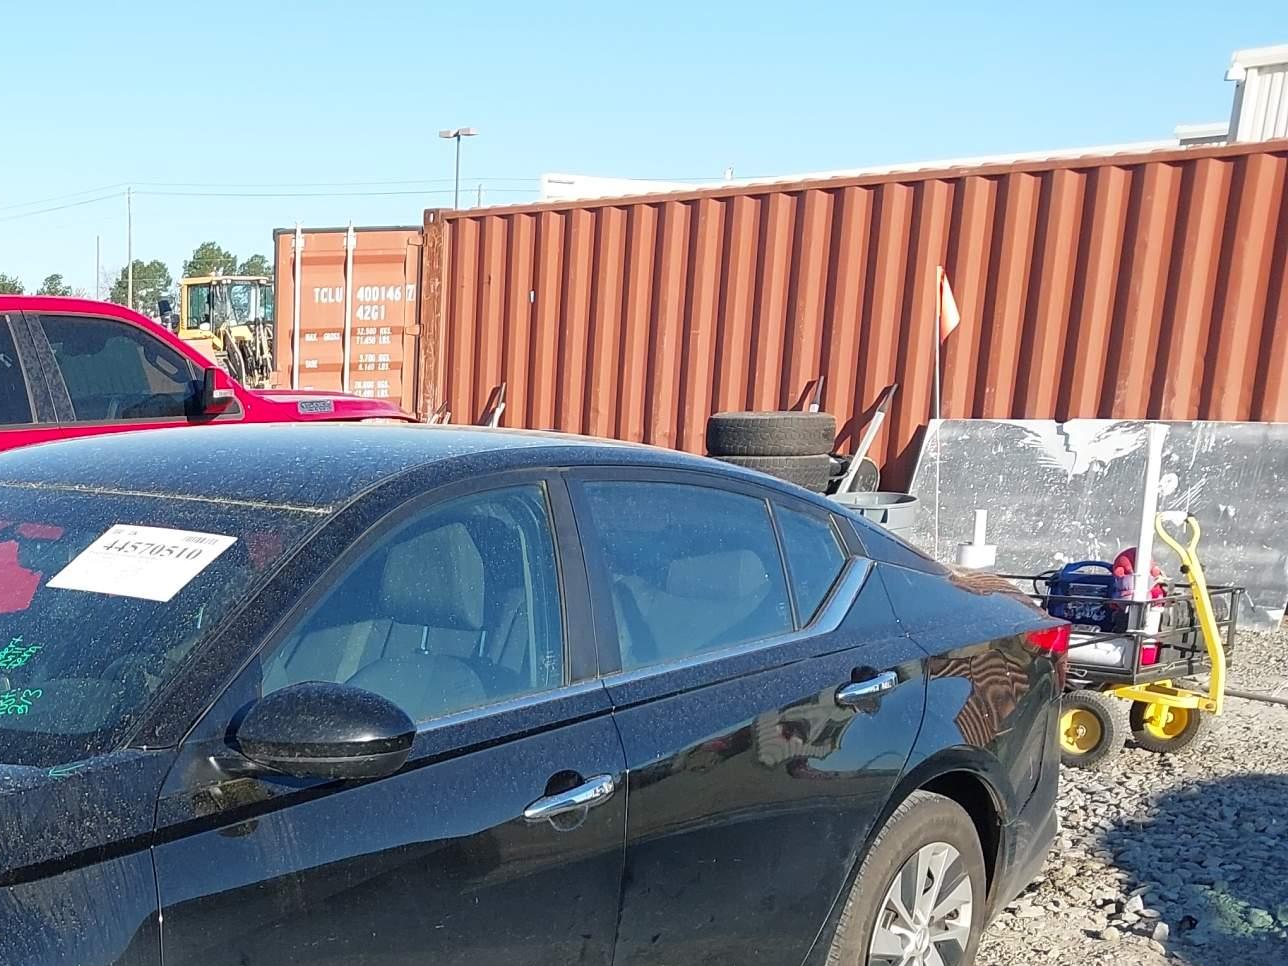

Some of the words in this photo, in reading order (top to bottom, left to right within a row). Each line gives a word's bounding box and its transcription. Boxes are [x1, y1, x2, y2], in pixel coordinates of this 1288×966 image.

[313, 287, 344, 304] TCLU
[356, 286, 402, 302] 400146
[356, 304, 385, 320] 42G1
[103, 540, 203, 560] 44570510
